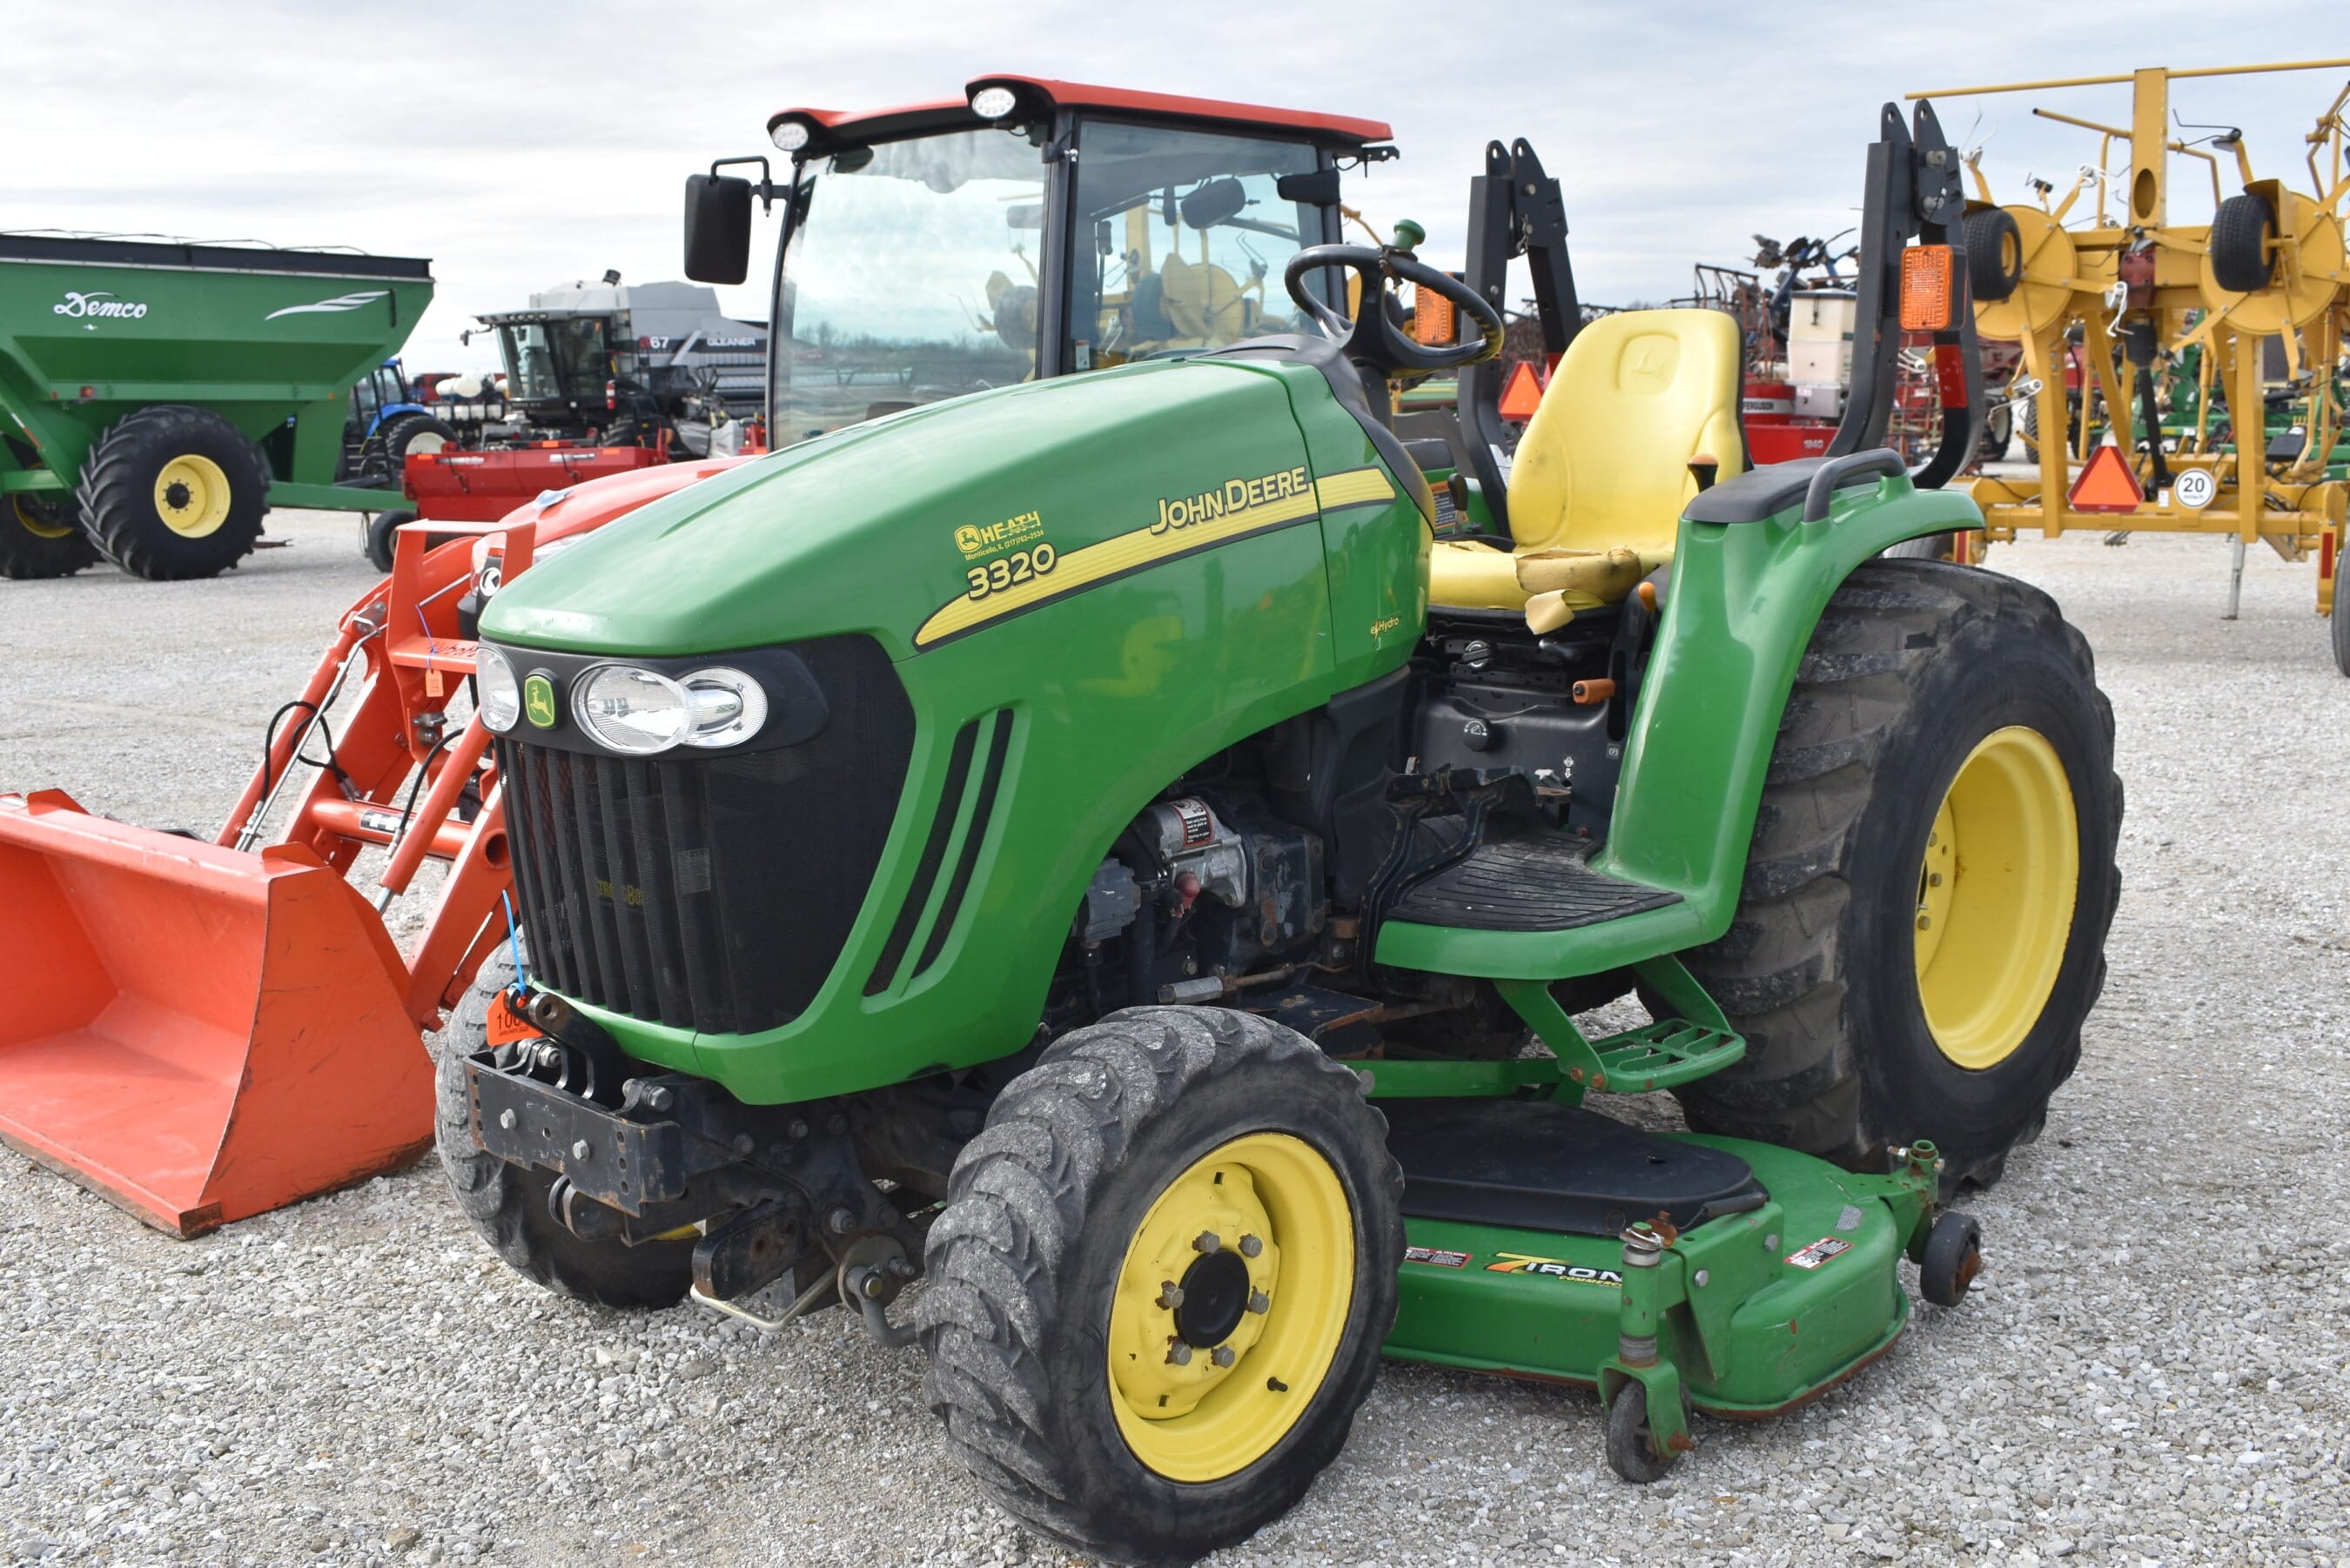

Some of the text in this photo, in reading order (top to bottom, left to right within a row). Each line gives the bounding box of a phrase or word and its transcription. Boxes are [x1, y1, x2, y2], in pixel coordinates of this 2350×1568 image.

[54, 291, 147, 318] Demco
[707, 337, 755, 346] GLEANER
[2183, 477, 2205, 493] 20
[1151, 466, 1308, 535] JOHN DEERE
[979, 510, 1042, 544] HEATH
[967, 542, 1056, 600] 3320
[1559, 1275, 1623, 1287] COMMERC
